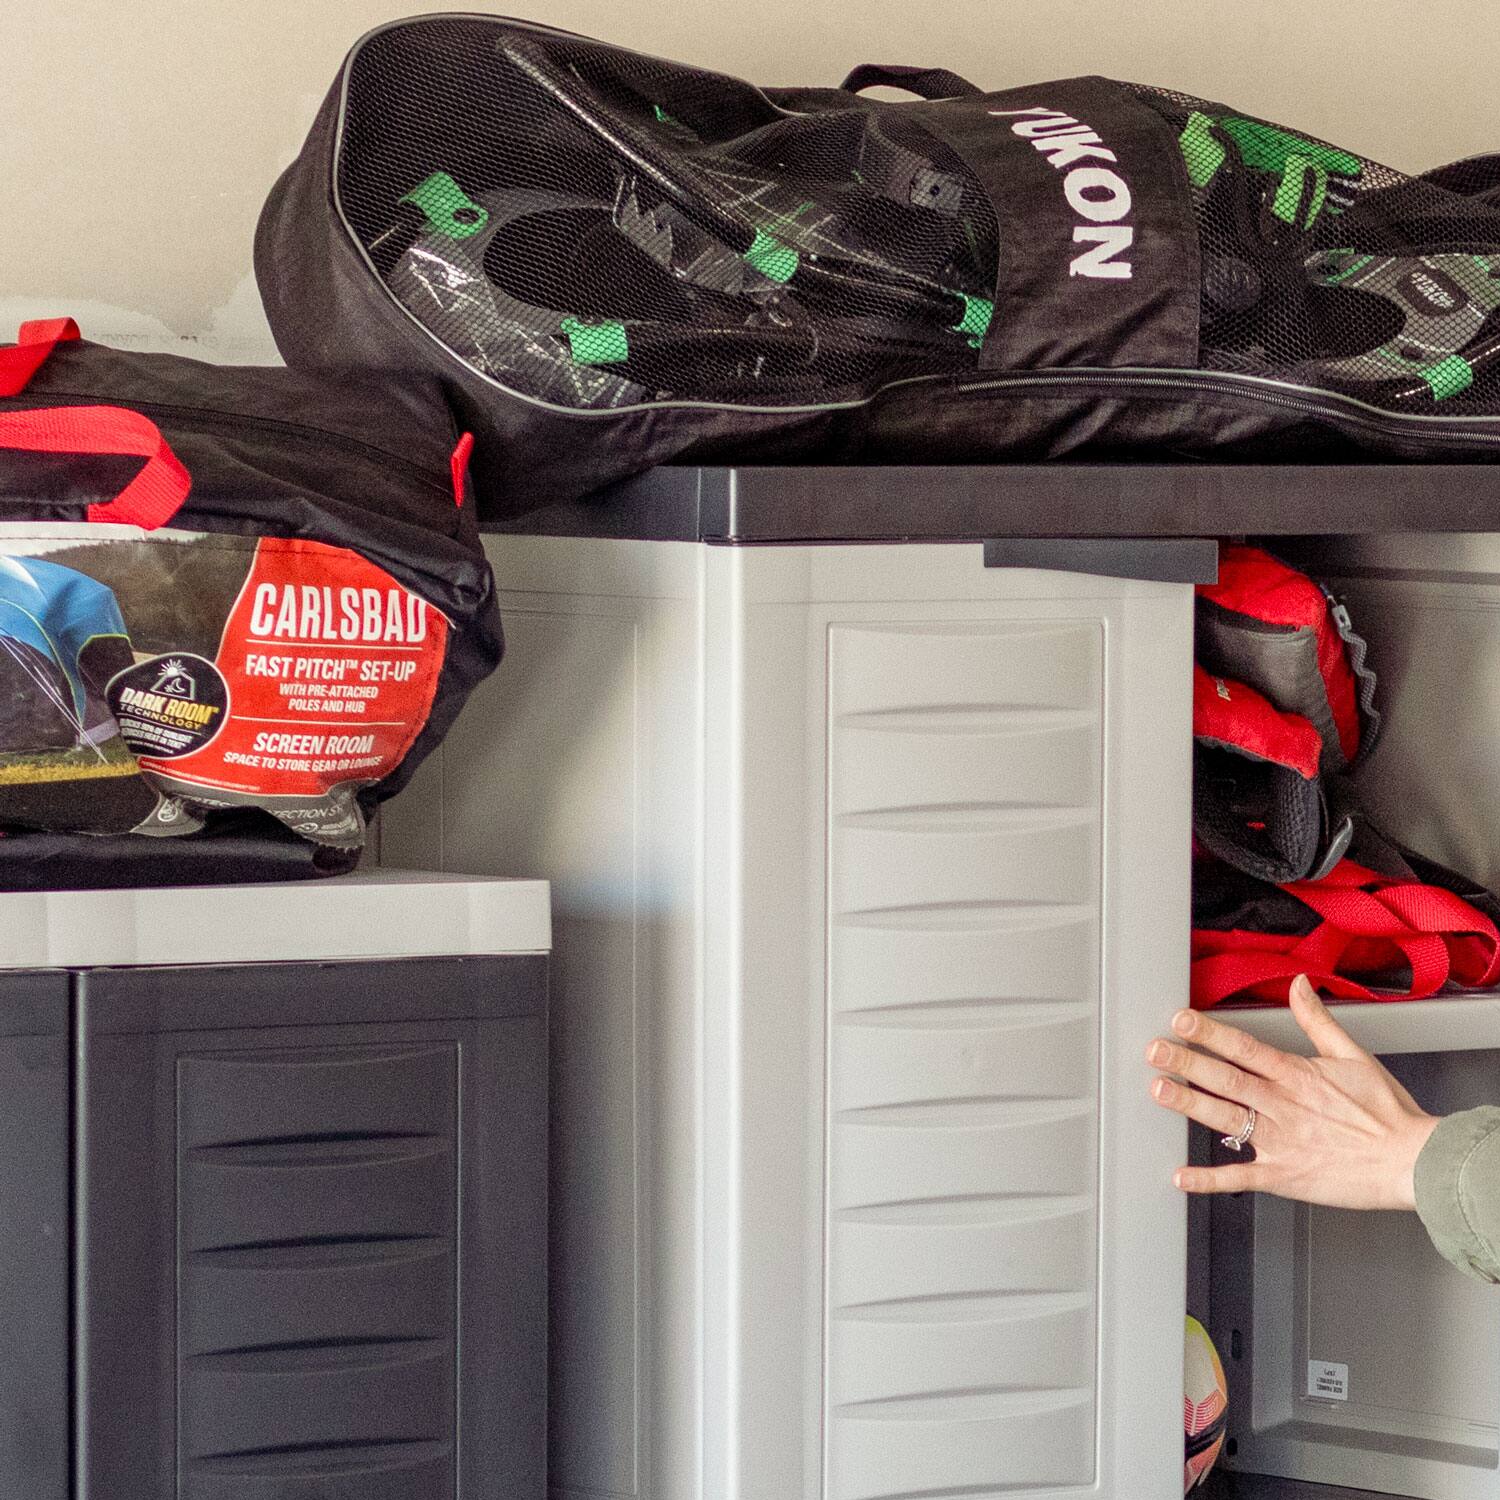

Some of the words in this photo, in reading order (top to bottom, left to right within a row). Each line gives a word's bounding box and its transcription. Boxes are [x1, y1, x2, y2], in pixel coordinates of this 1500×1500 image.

[988, 107, 1133, 278] YUKON
[250, 583, 427, 643] CARLSBAD
[245, 654, 294, 678] FAST
[360, 660, 417, 682] SET-UP
[119, 687, 168, 712] DARK
[279, 683, 307, 696] WITH
[307, 684, 378, 699] PRE-ATTACHED
[120, 703, 202, 730] TECHNOLOGY
[288, 699, 320, 712] POLES
[320, 700, 345, 713] AND
[345, 701, 366, 714] HUB
[253, 732, 326, 754] SCREEN
[325, 734, 375, 755] ROOM
[223, 751, 260, 767] SPACE
[261, 756, 276, 769] TO
[277, 758, 311, 772] STORE
[311, 760, 338, 772] GEAR
